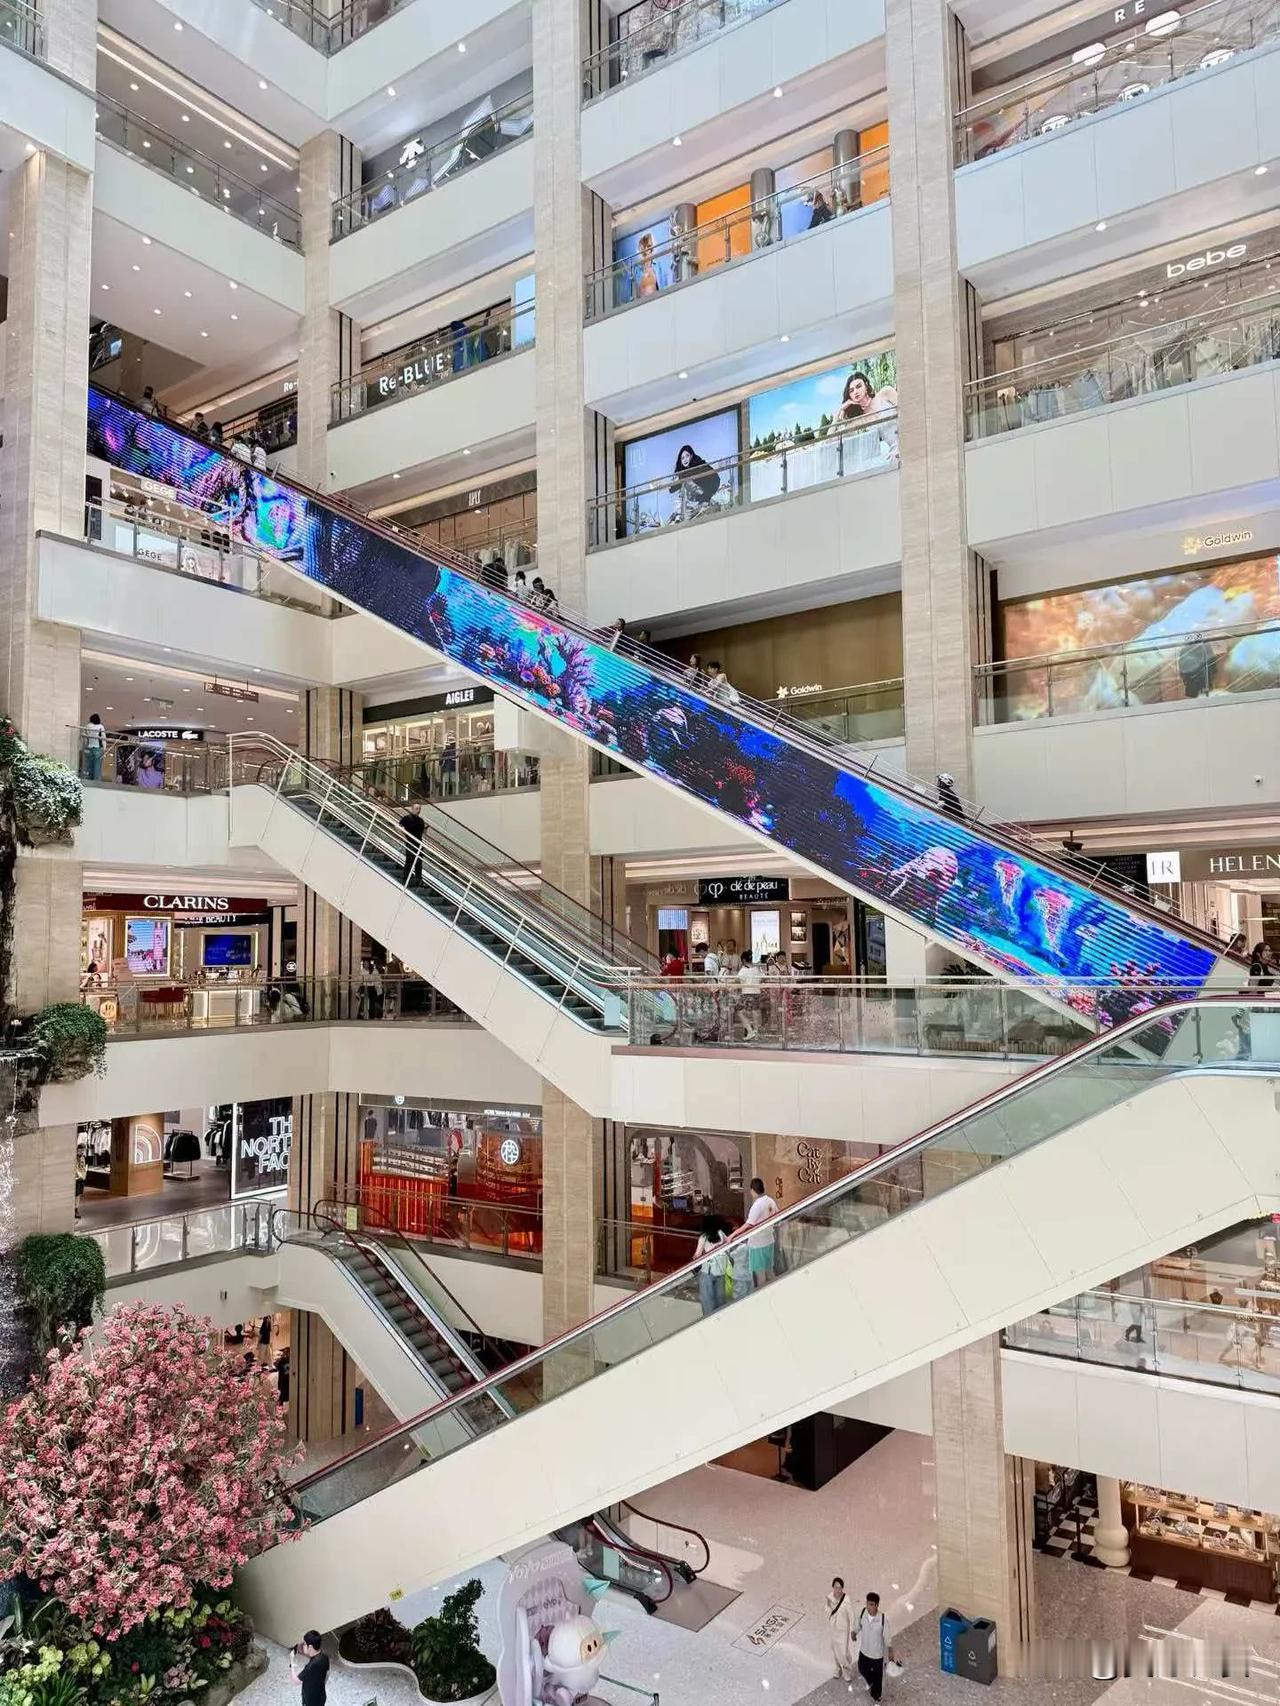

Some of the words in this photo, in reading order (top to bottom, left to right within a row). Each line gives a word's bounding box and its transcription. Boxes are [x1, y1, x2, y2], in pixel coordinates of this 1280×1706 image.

[1166, 244, 1247, 278] bebe
[379, 353, 444, 393] Re-BLUE
[283, 378, 299, 392] Re-
[1204, 530, 1252, 547] Goldwin
[446, 690, 470, 705] AIGLE
[790, 683, 822, 695] Goldwin
[138, 730, 178, 738] LACOSTE
[1210, 854, 1280, 873] HELEN
[744, 880, 755, 891] de
[757, 881, 778, 893] peau
[143, 895, 229, 910] CLARINS
[269, 1114, 292, 1135] TH
[241, 1132, 292, 1158] NORT
[797, 1141, 822, 1159] Cat
[807, 1157, 822, 1174] By
[797, 1166, 821, 1185] Cat
